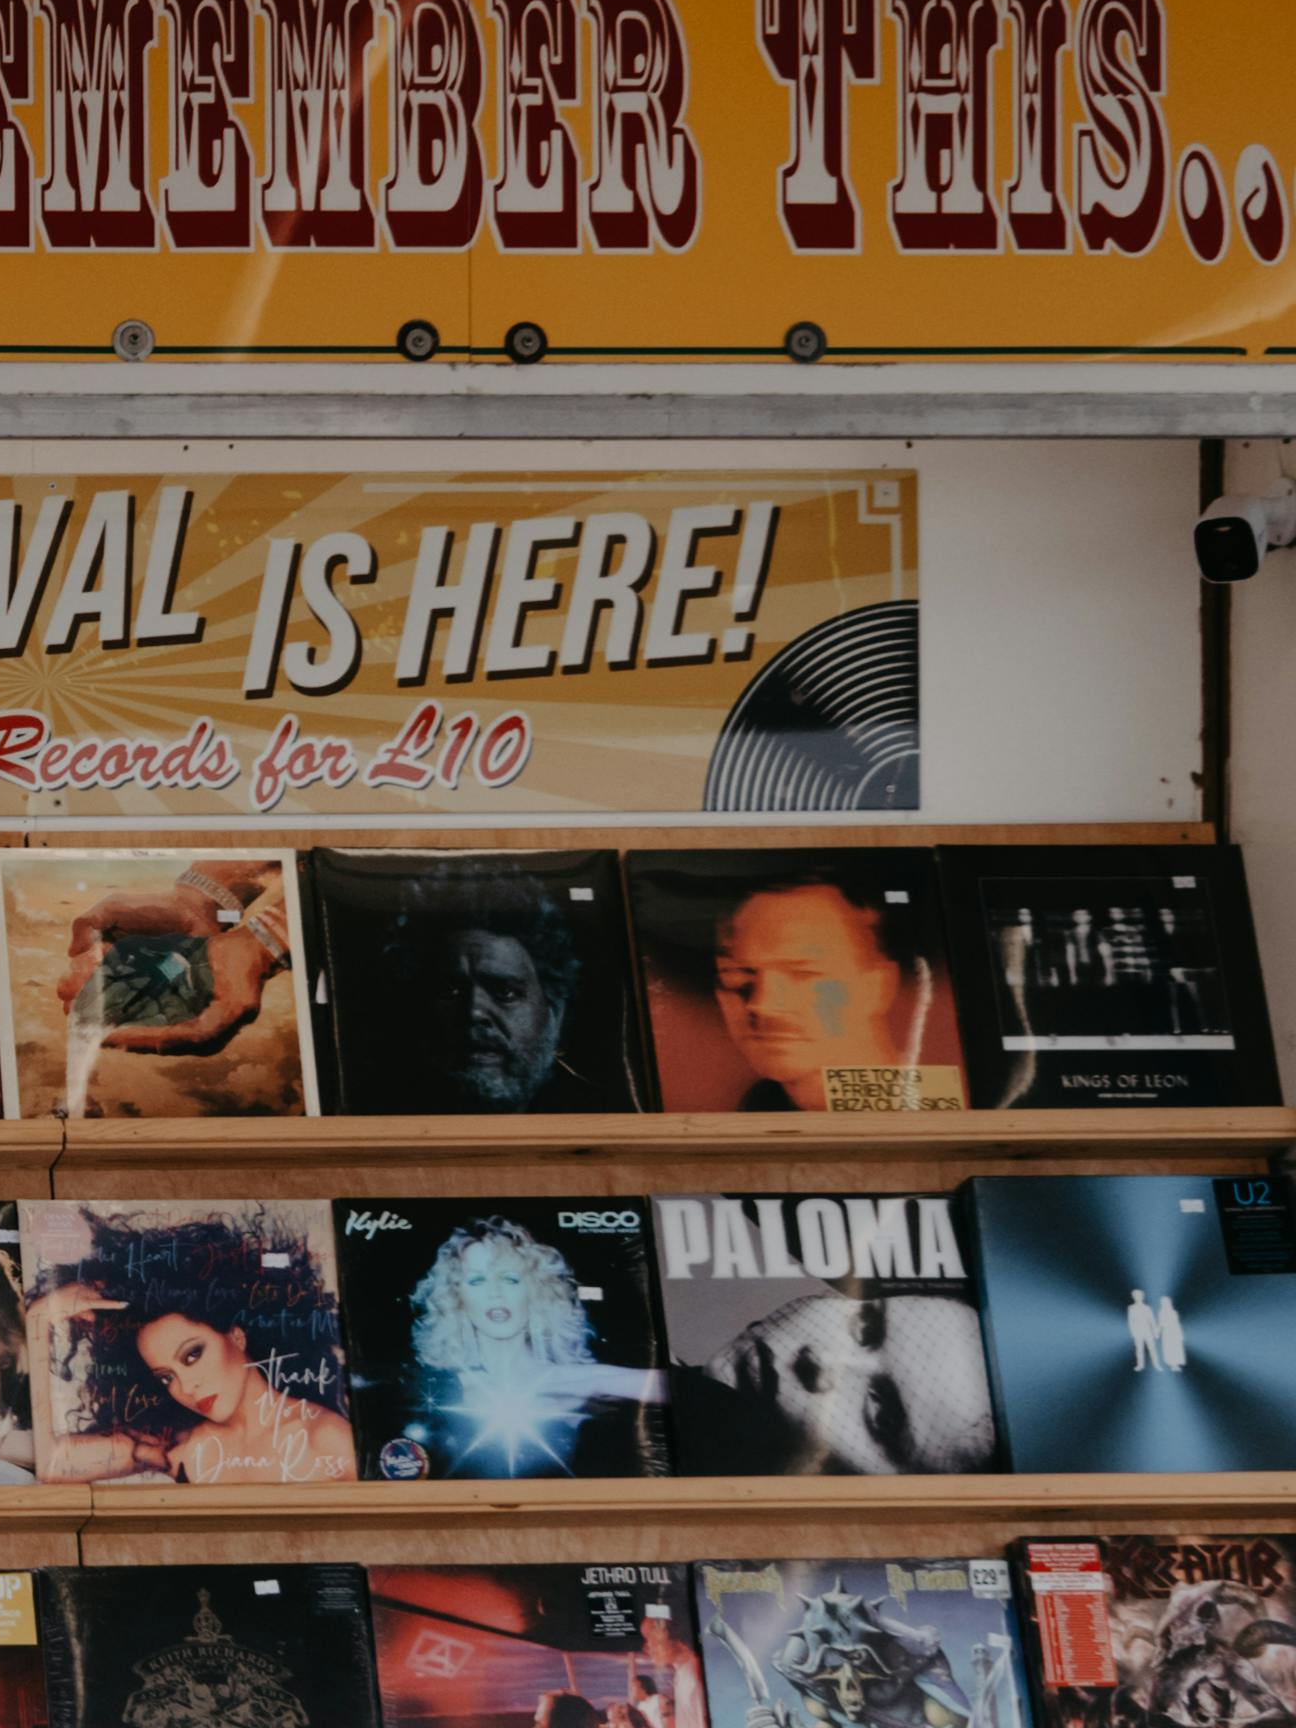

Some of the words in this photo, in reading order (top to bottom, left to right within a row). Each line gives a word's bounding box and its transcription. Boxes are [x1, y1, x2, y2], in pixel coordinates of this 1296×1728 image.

[241, 530, 379, 701] IS
[394, 500, 782, 690] HERE!
[249, 712, 358, 812] for
[368, 699, 534, 790] £10
[826, 1068, 870, 1085] PETE
[873, 1067, 920, 1084] TONG
[1061, 1073, 1111, 1088] KINGS
[1116, 1073, 1138, 1088] OF
[1144, 1072, 1189, 1088] LEON
[1233, 1181, 1272, 1206] U2
[345, 1210, 413, 1241] Kylie
[558, 1210, 640, 1230] DISCO
[657, 1197, 969, 1281] PALOMA
[244, 1346, 337, 1396] Thank
[191, 1435, 275, 1483] Diana
[277, 1428, 353, 1482] Ross
[580, 1566, 638, 1584] JETHRO
[638, 1566, 672, 1584] TULL
